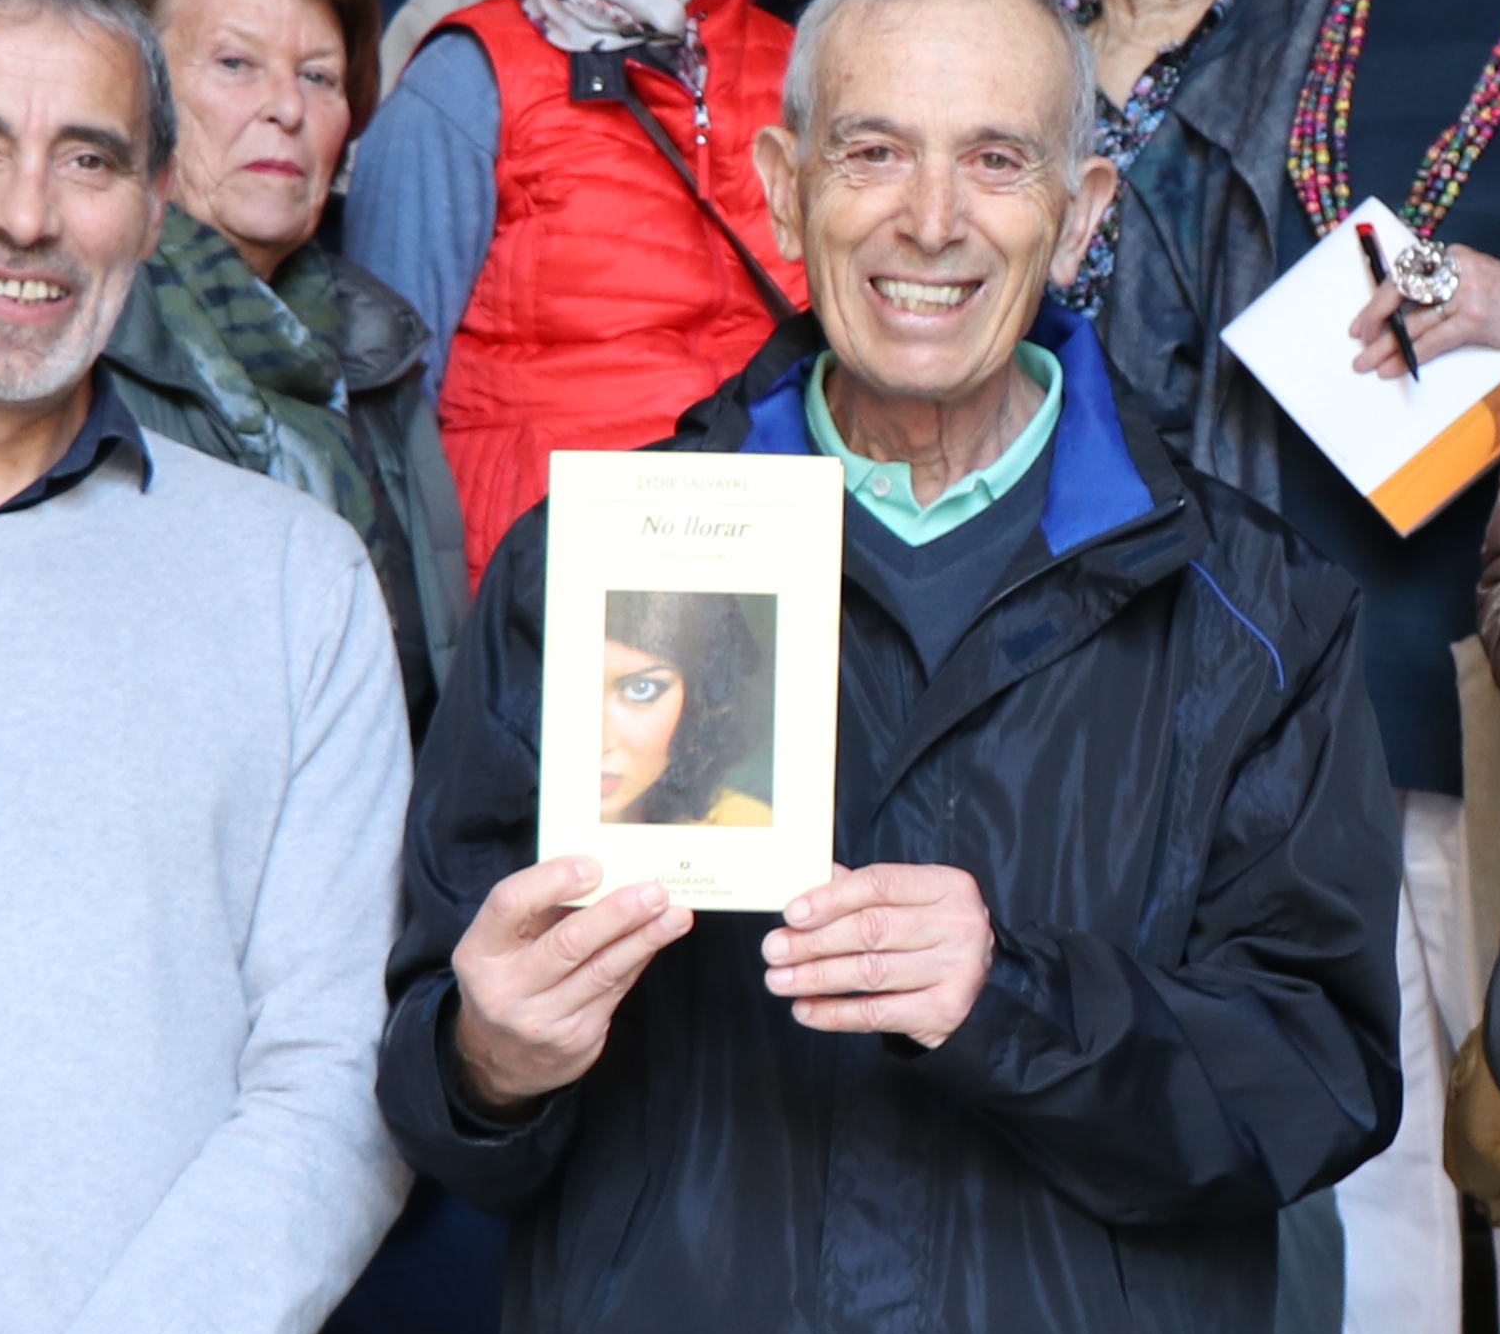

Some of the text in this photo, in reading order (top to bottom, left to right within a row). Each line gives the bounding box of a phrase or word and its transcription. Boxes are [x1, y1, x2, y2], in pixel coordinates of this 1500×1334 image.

[637, 476, 751, 492] LYDIE SALVAYRE
[640, 514, 752, 538] No llorar
